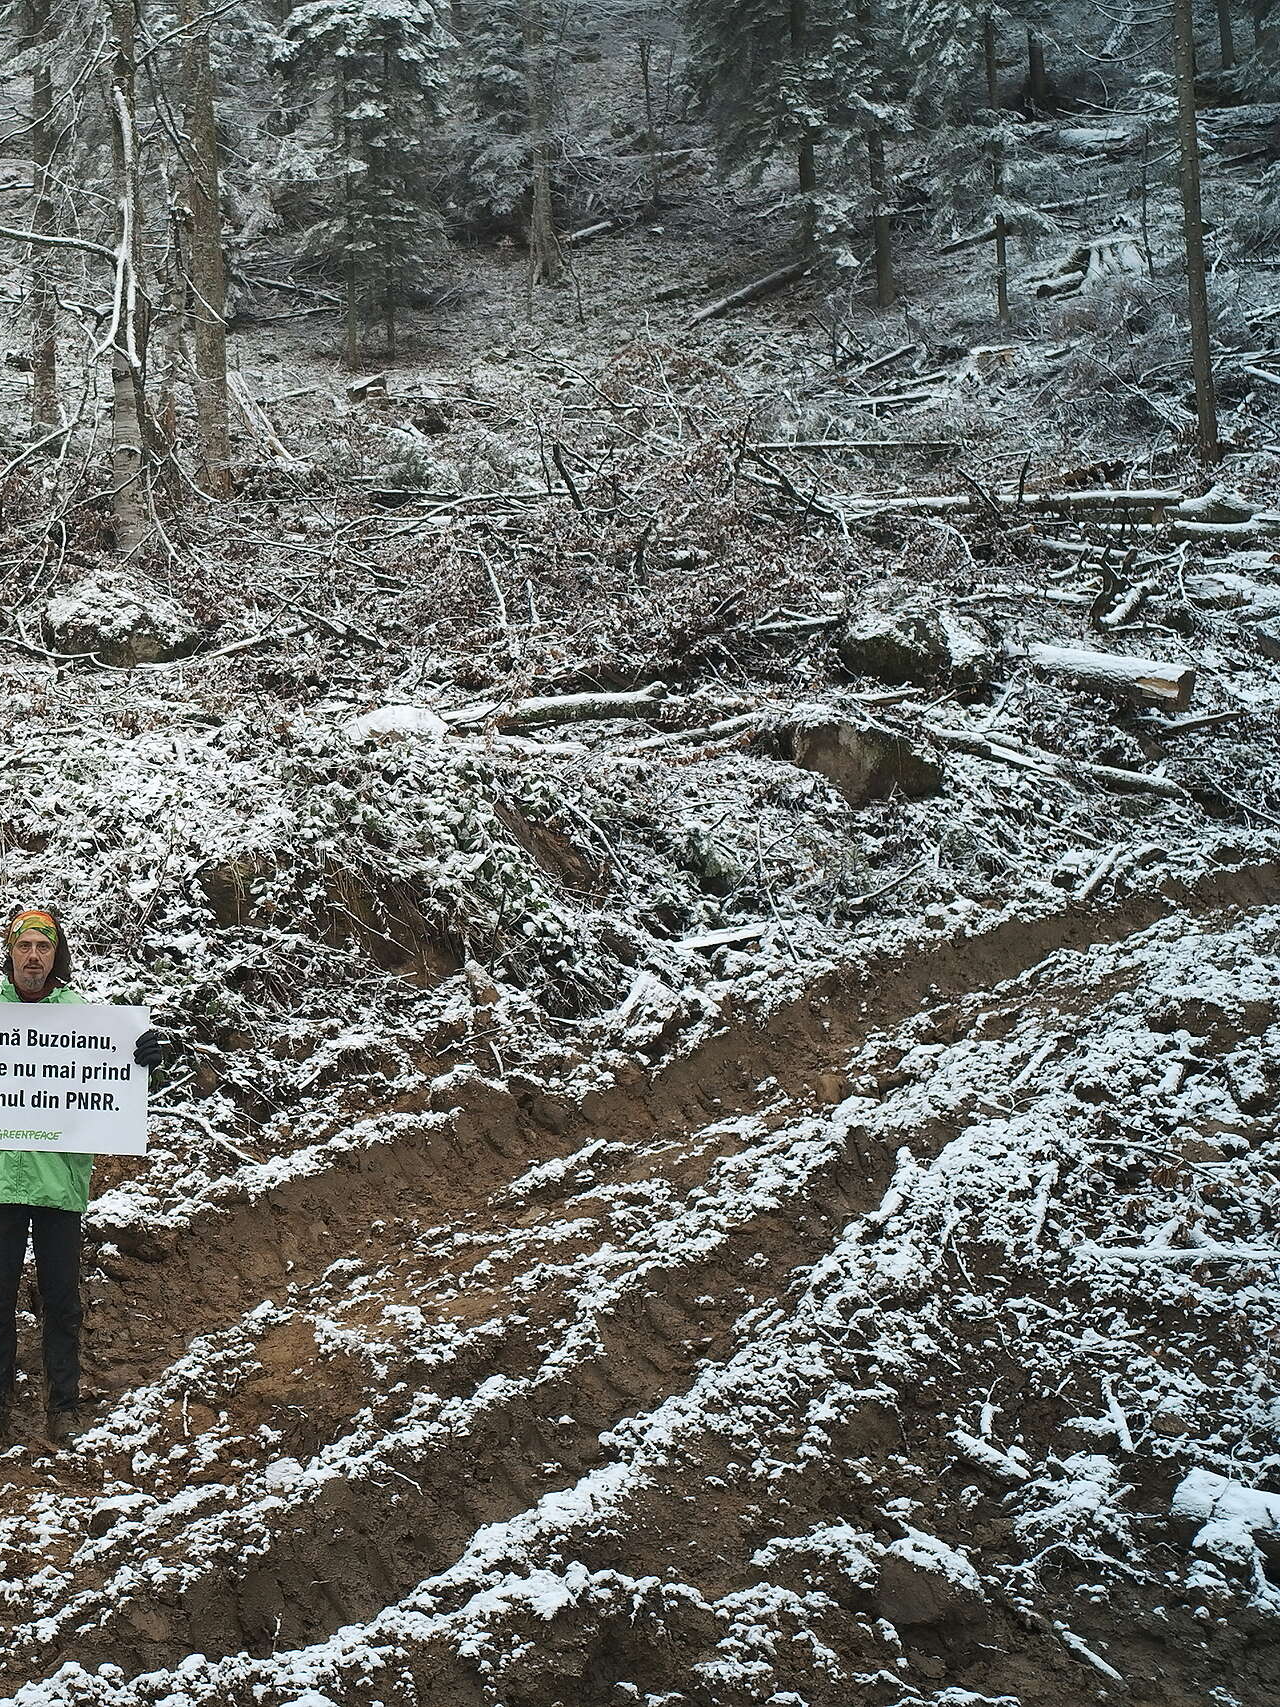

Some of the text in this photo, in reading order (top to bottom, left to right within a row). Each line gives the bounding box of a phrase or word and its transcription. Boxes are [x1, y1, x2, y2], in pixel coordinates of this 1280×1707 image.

[27, 1029, 117, 1053] Buzoianu,
[13, 1063, 36, 1077] nu
[42, 1061, 76, 1079] mai
[81, 1062, 131, 1083] prind
[31, 1091, 59, 1109] din
[66, 1092, 120, 1112] PNRR.
